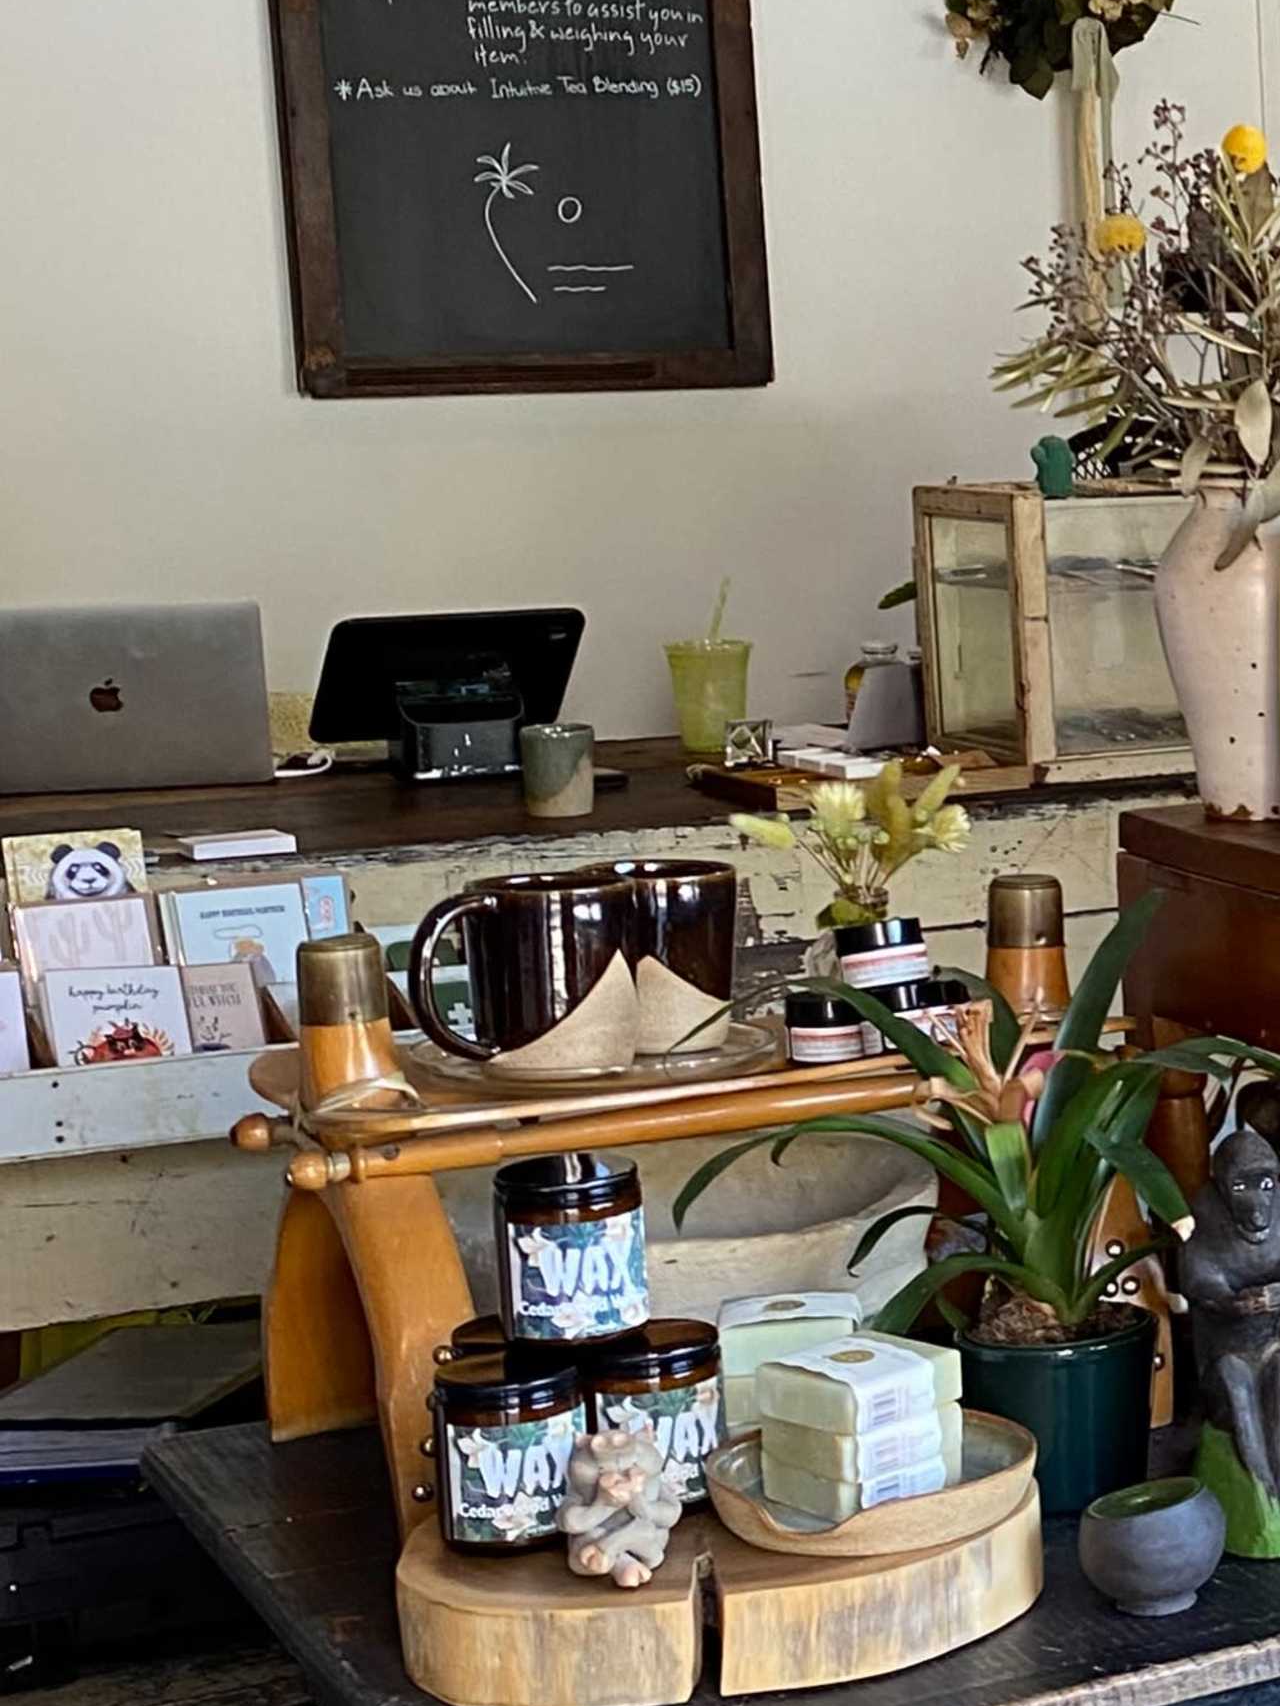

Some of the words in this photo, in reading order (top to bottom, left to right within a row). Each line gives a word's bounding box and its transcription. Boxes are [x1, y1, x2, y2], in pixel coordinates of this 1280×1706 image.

[467, 15, 527, 53] filling
[528, 20, 545, 39] &
[550, 22, 634, 56] weighing
[640, 33, 688, 55] your
[587, 0, 645, 20] assist
[649, 8, 683, 31] you
[687, 6, 704, 23] in
[403, 86, 423, 97] us
[557, 75, 587, 94] Tea
[593, 75, 659, 98] Blending
[666, 74, 702, 98] ($15)
[539, 1237, 634, 1297] WAX
[479, 1433, 575, 1499] WAX
